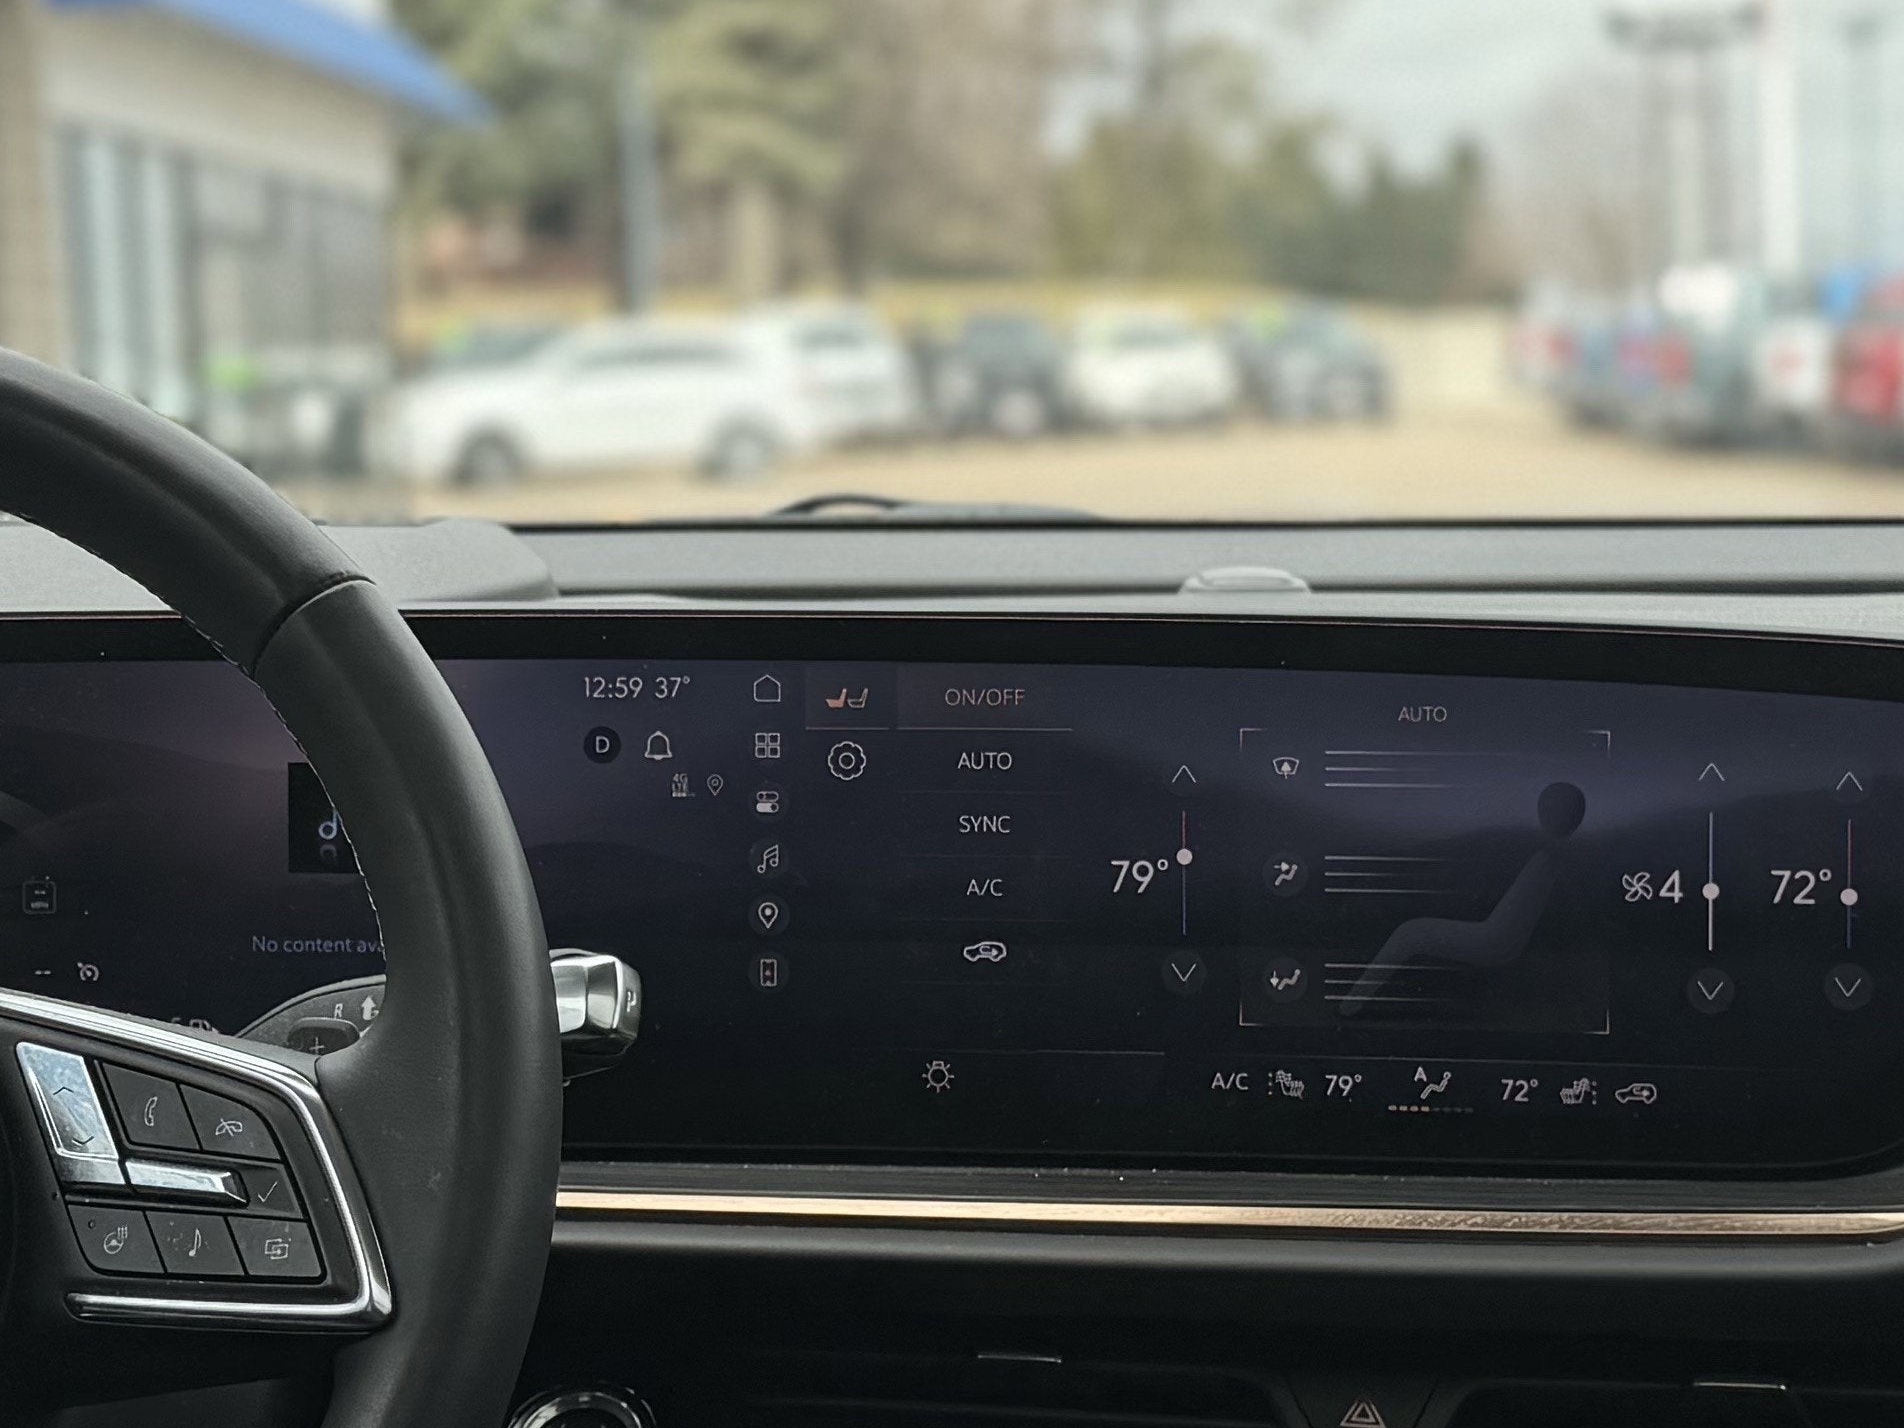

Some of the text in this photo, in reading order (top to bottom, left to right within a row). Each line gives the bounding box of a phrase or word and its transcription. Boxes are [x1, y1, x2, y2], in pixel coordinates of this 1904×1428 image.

[583, 675, 691, 698] 12:59 37°
[944, 688, 1026, 707] ON/OFF
[1398, 705, 1447, 723] AUTO
[957, 752, 1013, 770] AUTO
[958, 815, 1011, 834] SYNC
[1110, 859, 1169, 894] 79°
[966, 878, 1003, 897] A/C
[1658, 871, 1684, 905] 4
[1769, 868, 1832, 906] 72°
[251, 935, 278, 953] No
[283, 936, 352, 953] content
[334, 1002, 343, 1019] R
[1211, 1072, 1249, 1092] A/C
[1324, 1074, 1363, 1097] 79°
[1500, 1078, 1539, 1102] 72°
